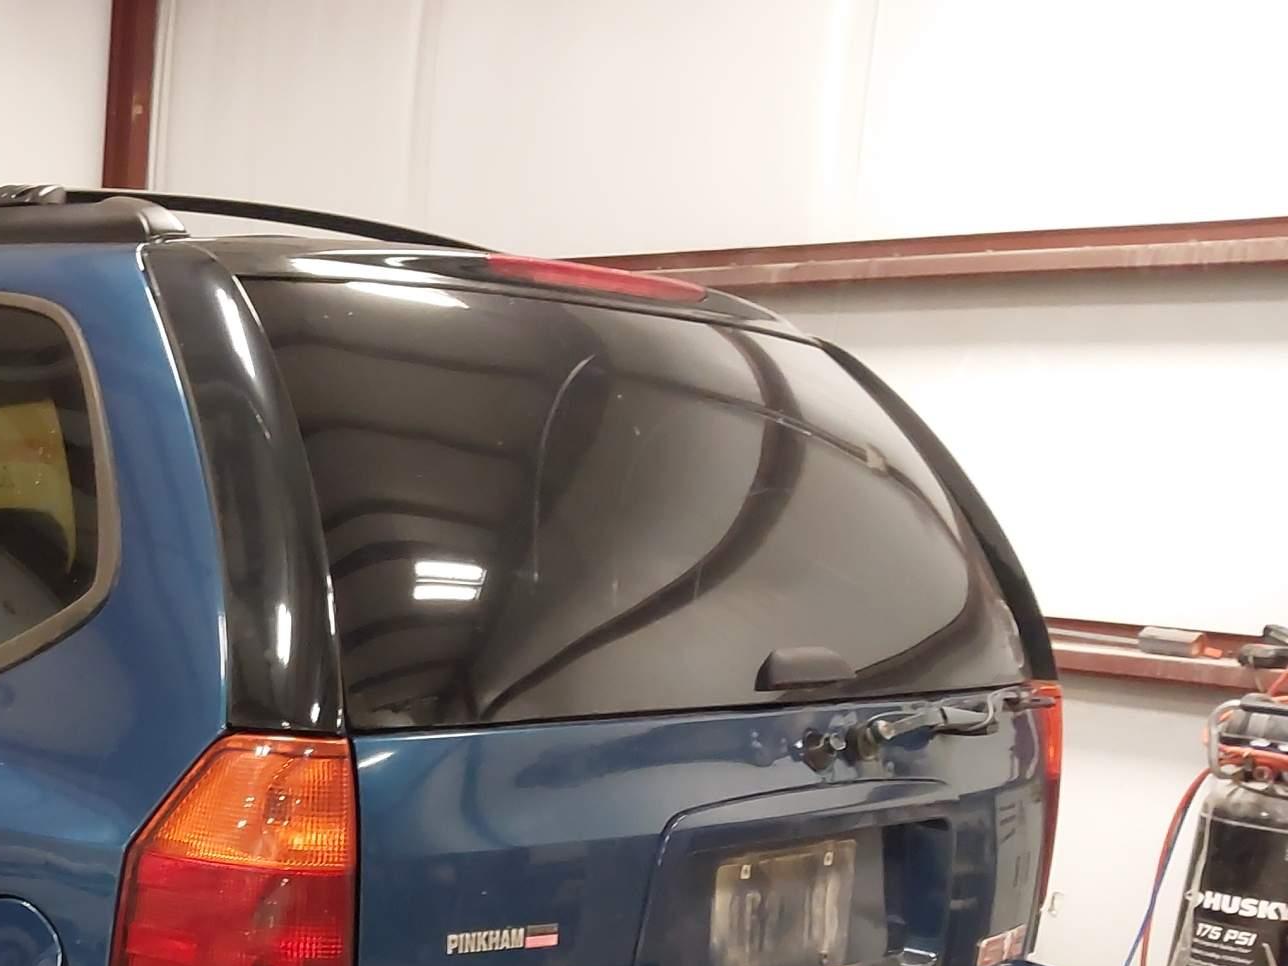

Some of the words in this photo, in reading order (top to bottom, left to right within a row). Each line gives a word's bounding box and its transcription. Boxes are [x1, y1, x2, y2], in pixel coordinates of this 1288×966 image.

[1202, 890, 1288, 921] HUSKY
[446, 927, 525, 955] PINKHAM
[1196, 923, 1223, 940] 175
[1223, 929, 1257, 946] PSI
